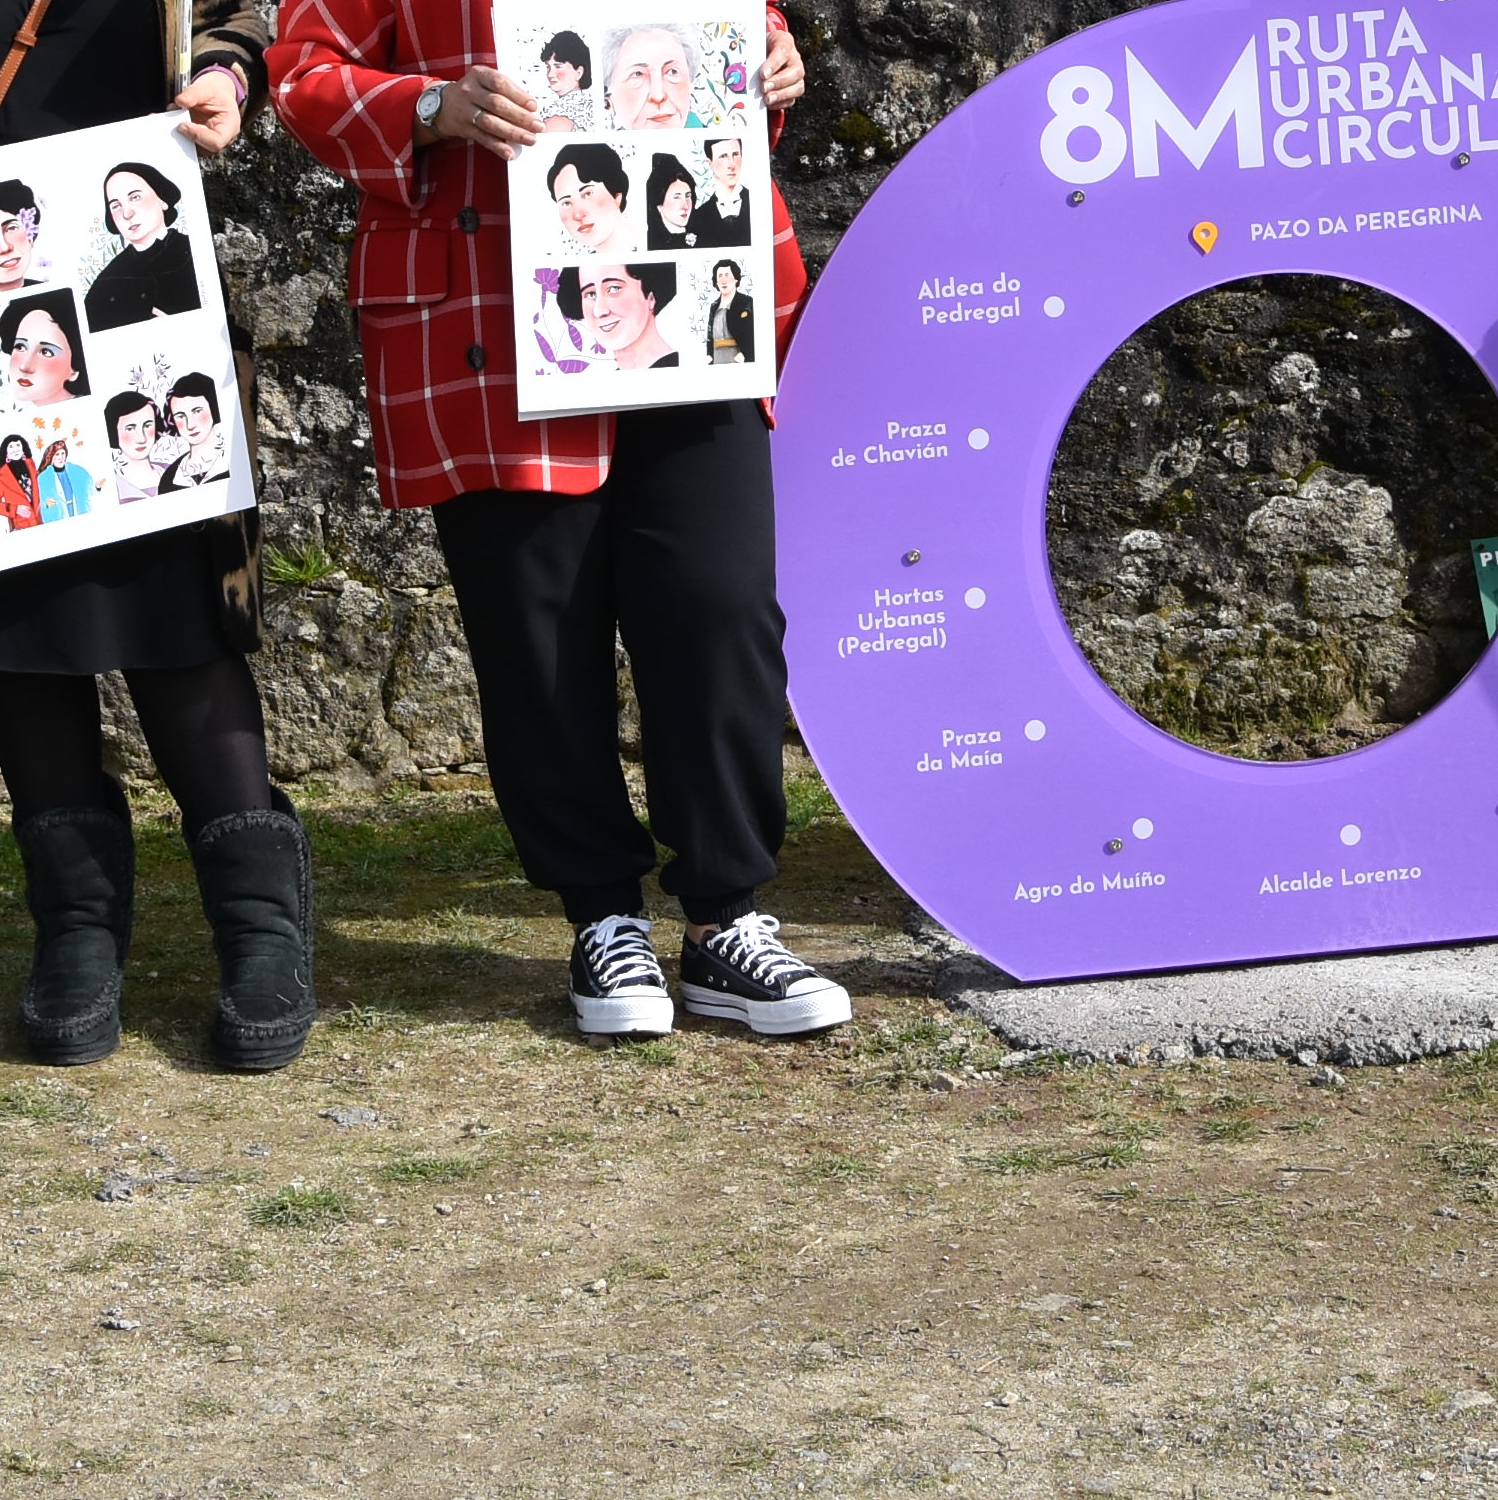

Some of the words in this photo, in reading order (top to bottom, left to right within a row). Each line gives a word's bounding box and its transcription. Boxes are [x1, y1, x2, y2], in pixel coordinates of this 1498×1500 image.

[1267, 7, 1427, 67] RUTA
[1040, 35, 1264, 184] 8M
[1251, 219, 1310, 241] PAZO
[1319, 216, 1348, 234] DA
[1356, 204, 1482, 231] PEREGRINA
[918, 277, 983, 300] Aldea
[993, 272, 1020, 294] do
[921, 297, 1019, 324] Pedregal
[888, 422, 946, 441] Praza
[832, 448, 856, 467] de
[864, 440, 947, 463] Chavián
[875, 588, 943, 607] Hortas
[859, 607, 946, 629] Urbanas
[838, 627, 946, 658] (Pedregal)
[943, 730, 1000, 747] Praza
[917, 753, 942, 772] da
[951, 747, 1002, 768] Maía
[1014, 883, 1062, 903] Agro
[1070, 875, 1094, 894] do
[1103, 868, 1165, 890] Muíño
[1260, 870, 1333, 894] Alcalde
[1342, 867, 1421, 885] Lorenzo
